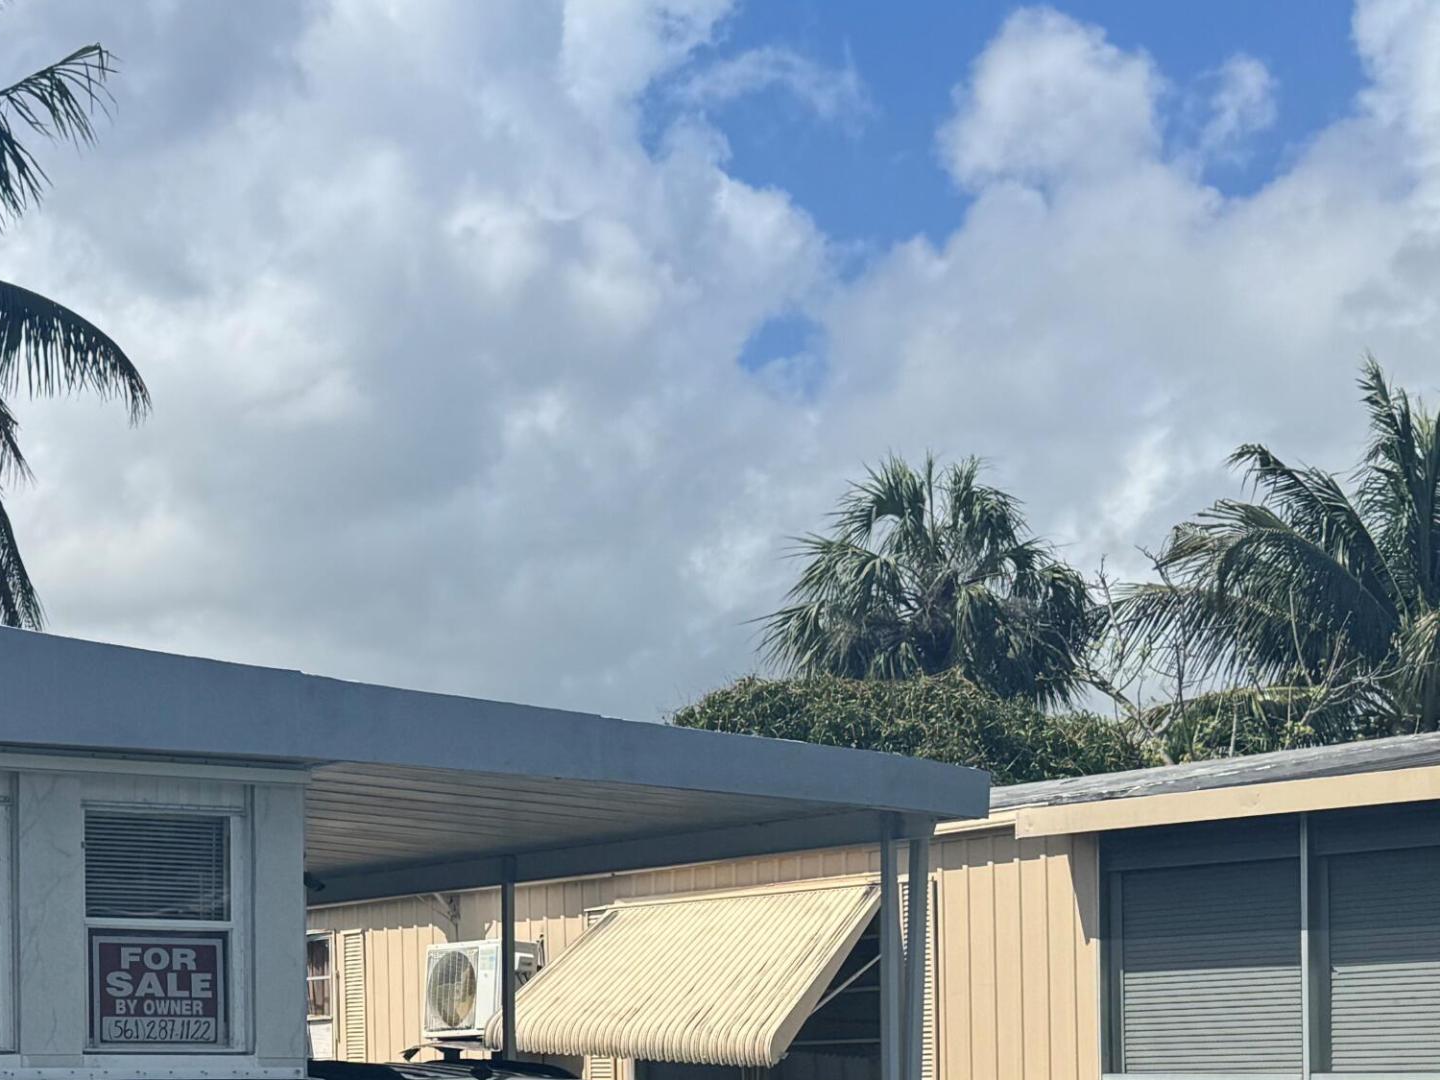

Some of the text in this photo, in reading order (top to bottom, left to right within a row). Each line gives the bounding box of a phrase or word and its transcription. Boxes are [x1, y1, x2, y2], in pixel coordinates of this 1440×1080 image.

[120, 946, 197, 971] FOR
[105, 970, 213, 998] SALE
[115, 999, 203, 1015] BY OWNER
